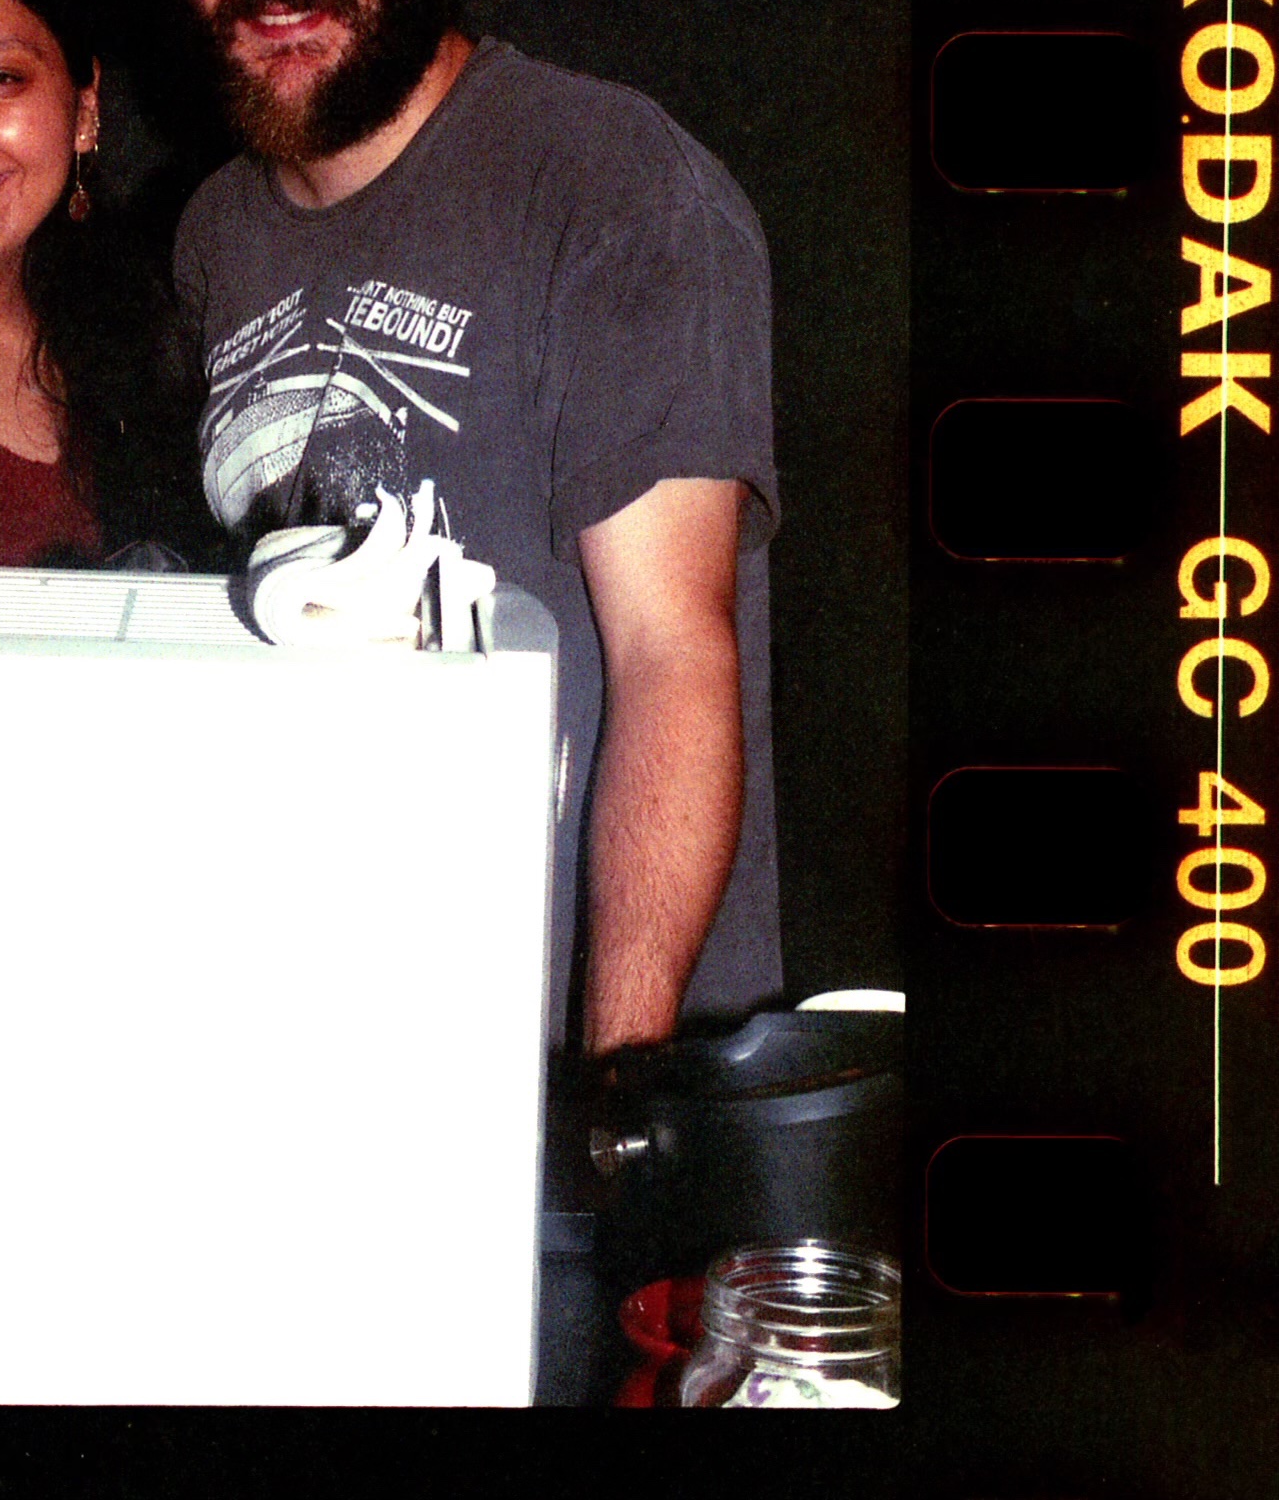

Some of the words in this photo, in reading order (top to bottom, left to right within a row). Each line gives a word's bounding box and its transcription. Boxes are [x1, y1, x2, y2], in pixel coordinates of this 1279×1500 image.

[384, 286, 438, 317] NOTHING
[437, 303, 473, 328] BUT
[1176, 536, 1272, 717] GC
[1175, 772, 1267, 986] 400
